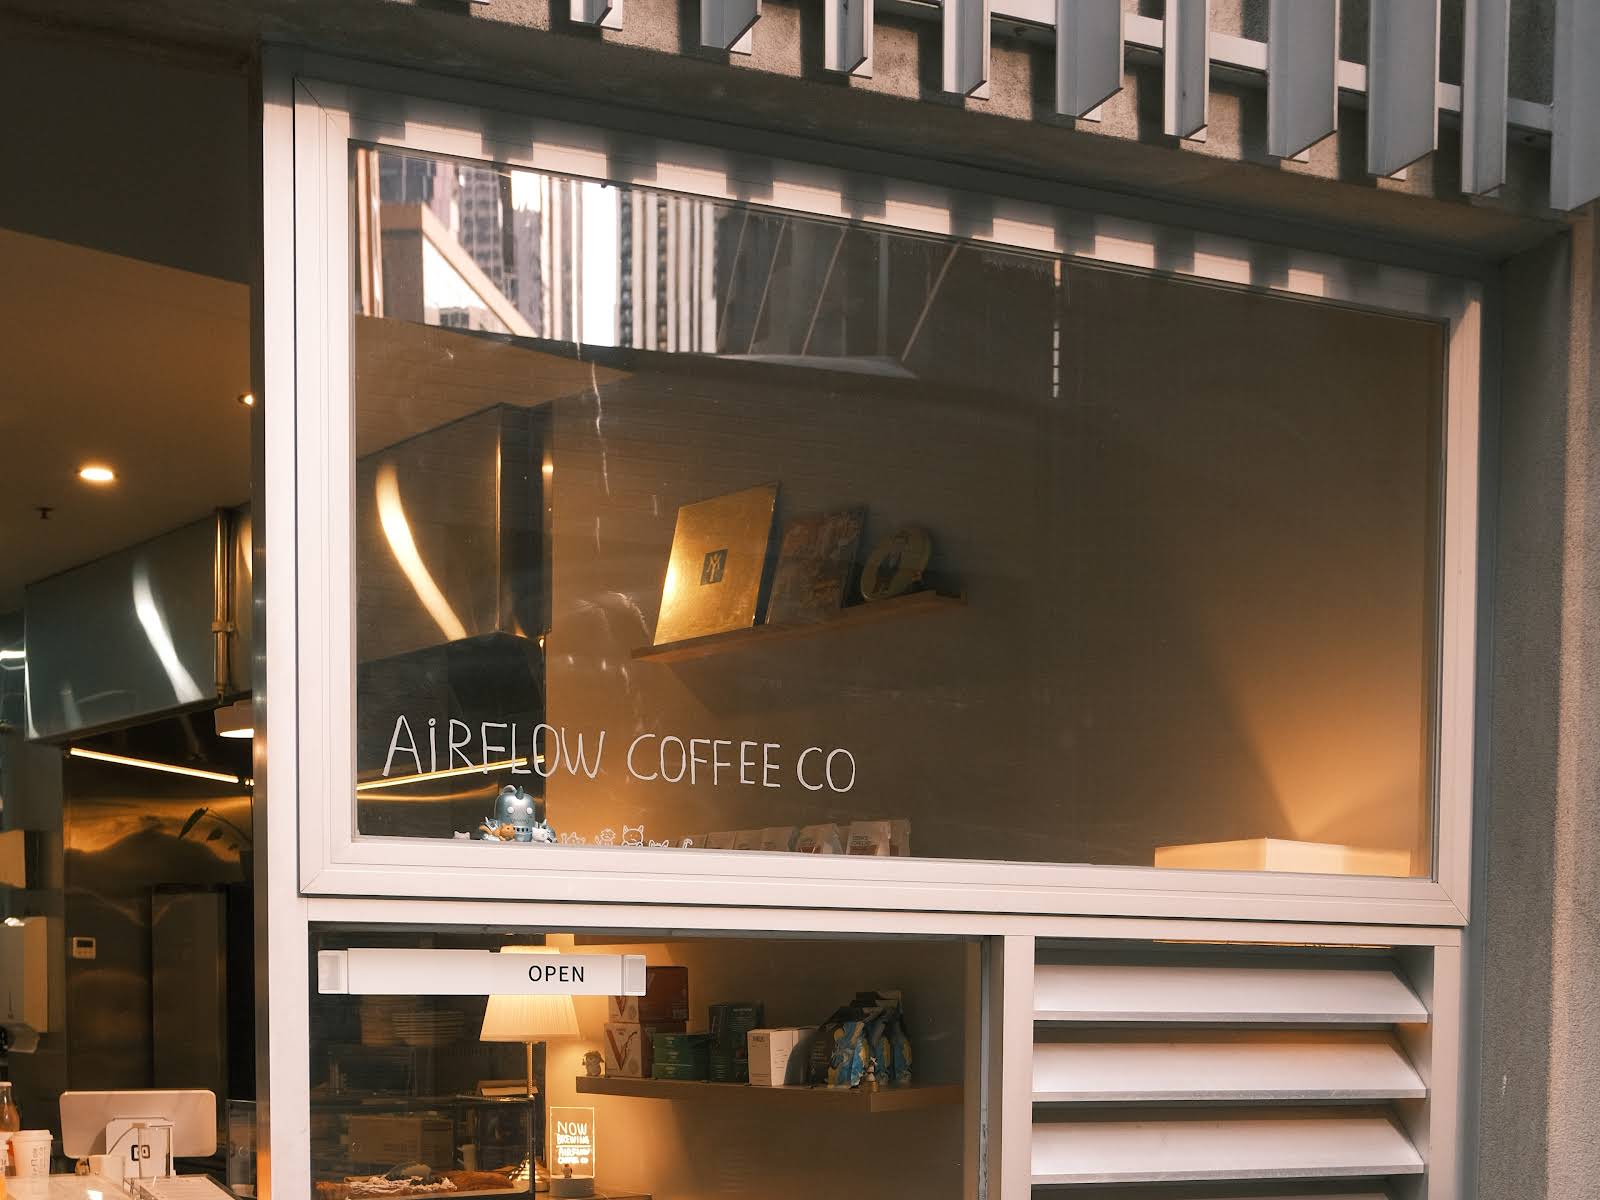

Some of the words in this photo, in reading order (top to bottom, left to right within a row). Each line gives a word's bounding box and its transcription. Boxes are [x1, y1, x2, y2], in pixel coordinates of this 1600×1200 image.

[627, 733, 782, 789] COFFEE
[795, 746, 858, 793] CO
[528, 965, 585, 983] OPEN
[557, 1120, 588, 1136] NOW
